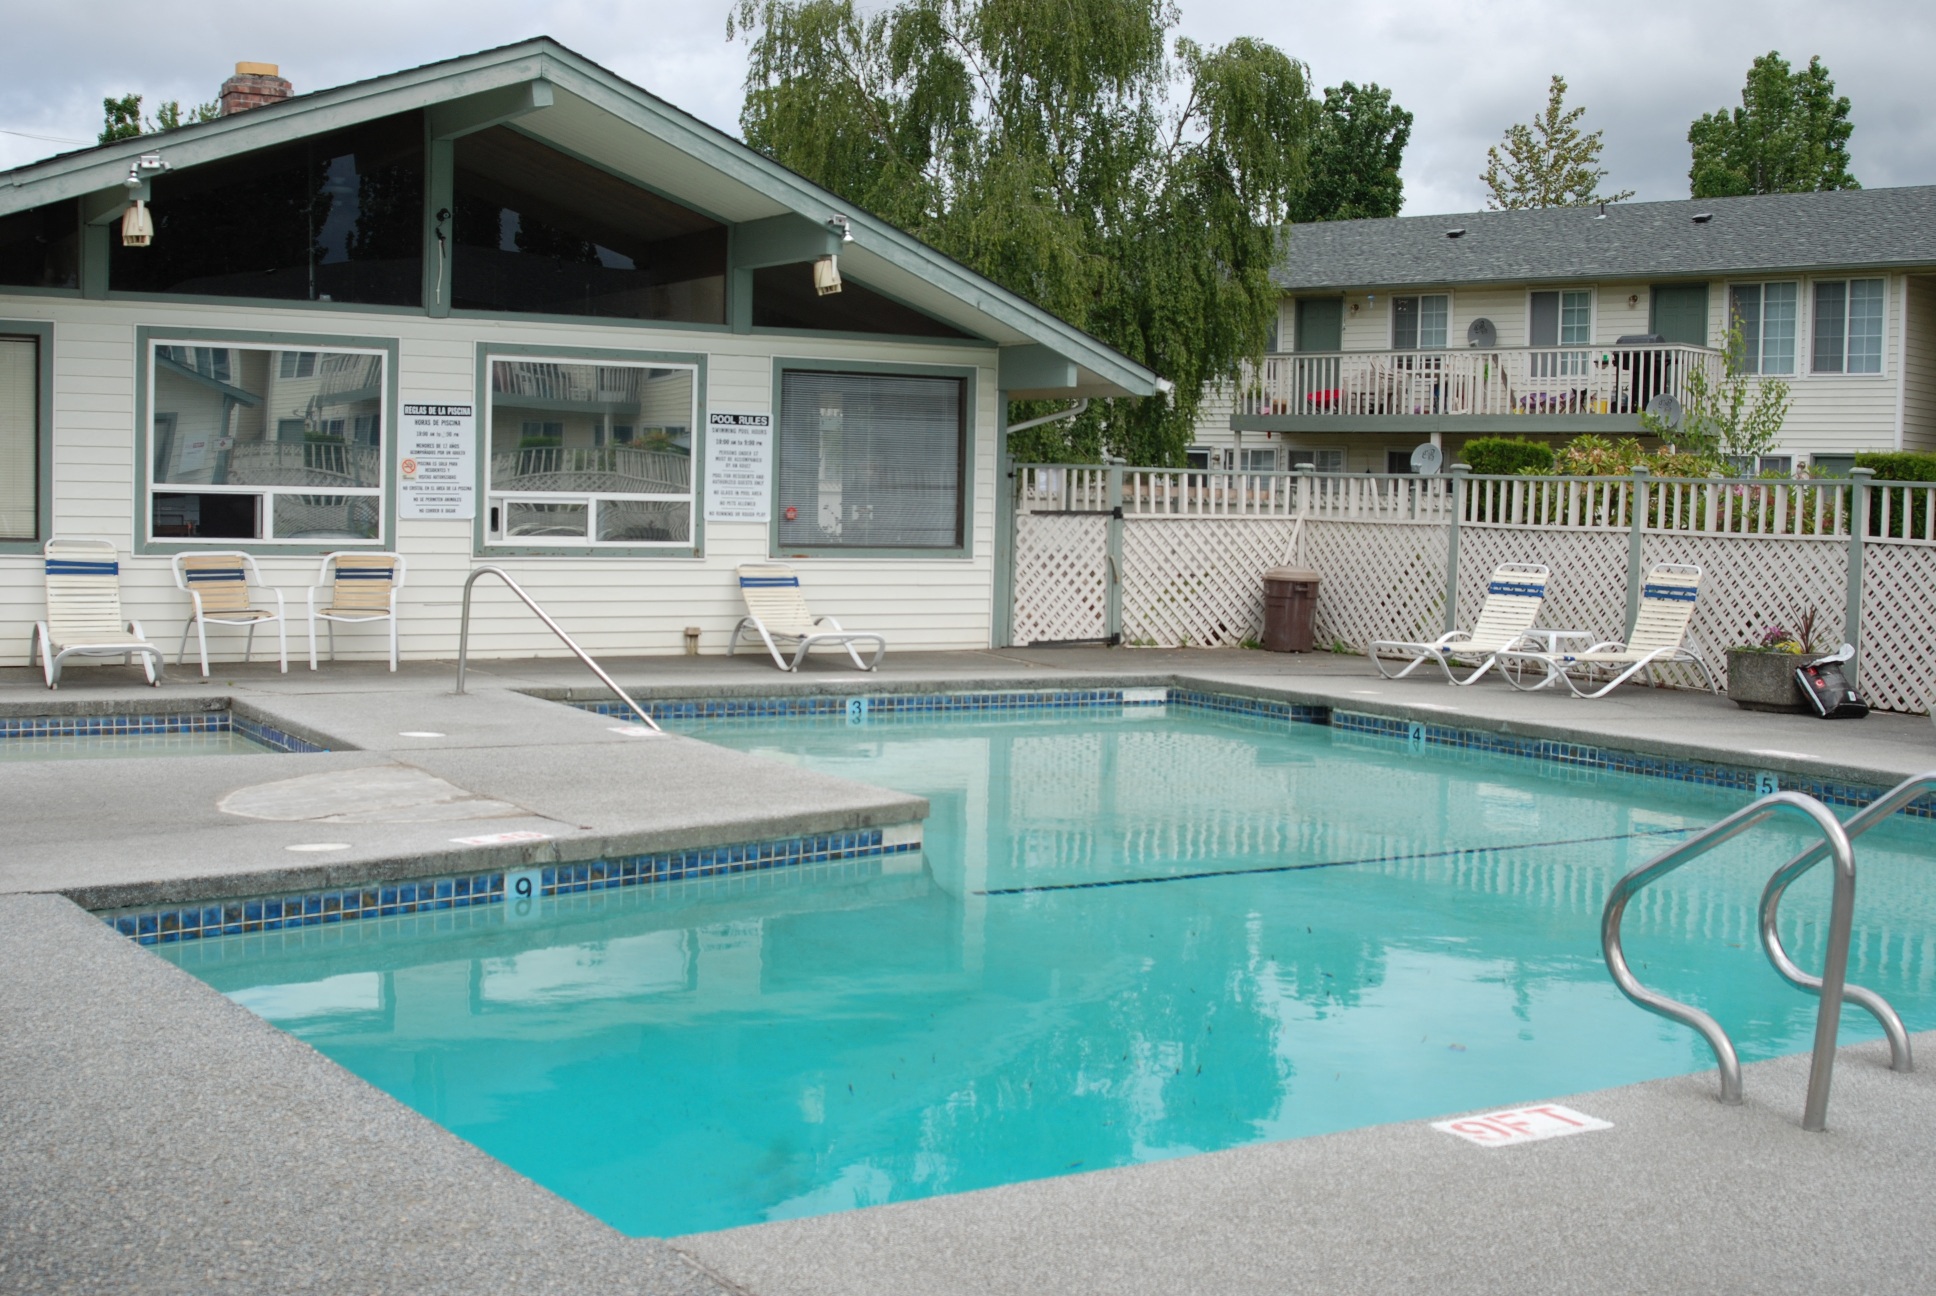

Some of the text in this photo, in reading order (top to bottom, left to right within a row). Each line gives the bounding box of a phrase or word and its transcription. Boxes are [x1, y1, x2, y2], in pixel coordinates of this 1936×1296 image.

[405, 406, 427, 414] REGLAS
[448, 407, 470, 415] PISCINA
[712, 415, 767, 425] POOL RULES
[1412, 727, 1421, 740] 4
[1761, 777, 1773, 794] 5
[515, 876, 532, 898] 9
